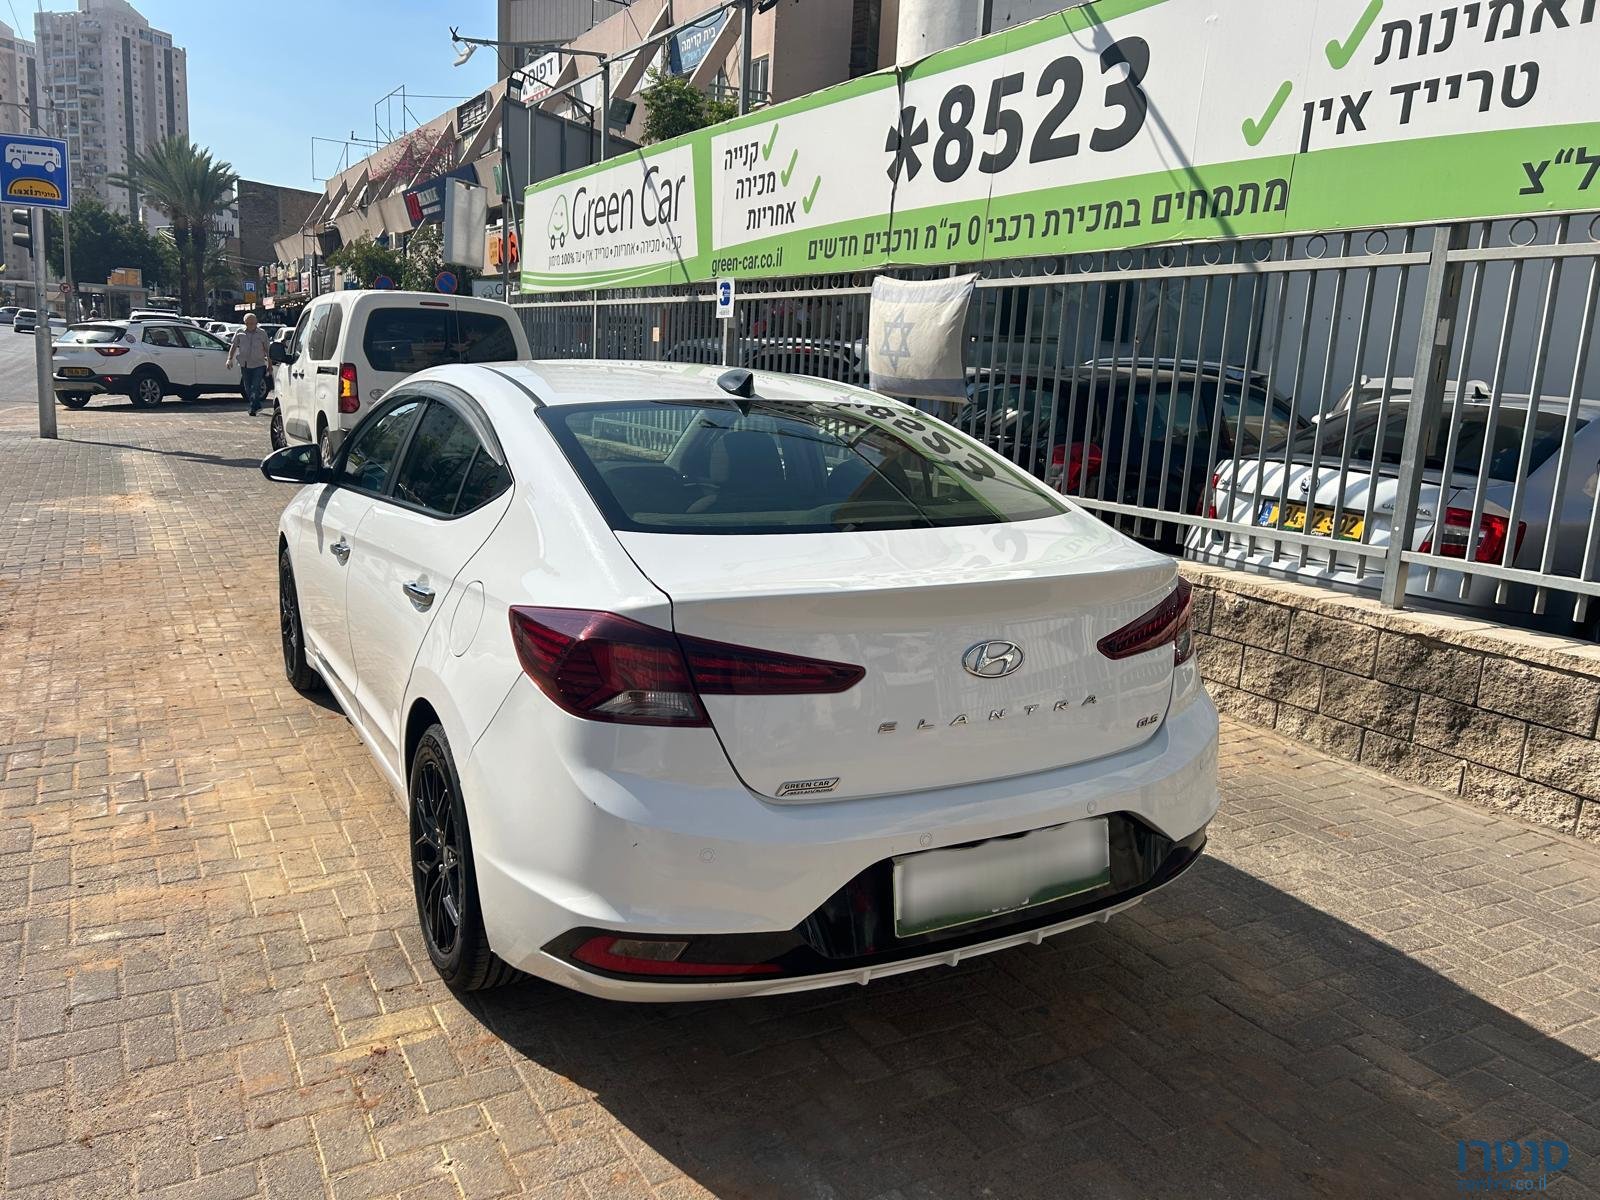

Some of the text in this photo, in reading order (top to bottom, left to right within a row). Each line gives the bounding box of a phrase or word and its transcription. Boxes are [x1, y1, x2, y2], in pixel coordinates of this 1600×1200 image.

[528, 58, 553, 86] דפוס
[1299, 61, 1540, 154] טרייד אין
[724, 142, 759, 171] קנייה
[736, 171, 776, 200] מכירה
[572, 165, 685, 240] Green Car
[746, 201, 796, 230] אחריות
[808, 178, 1288, 260] מתמחים במכירת רכבי 0 ק"מ ורכבים חדשים
[711, 246, 783, 277] green-car.co.il
[877, 694, 1097, 735] ELANTRA
[784, 782, 811, 790] GREEN
